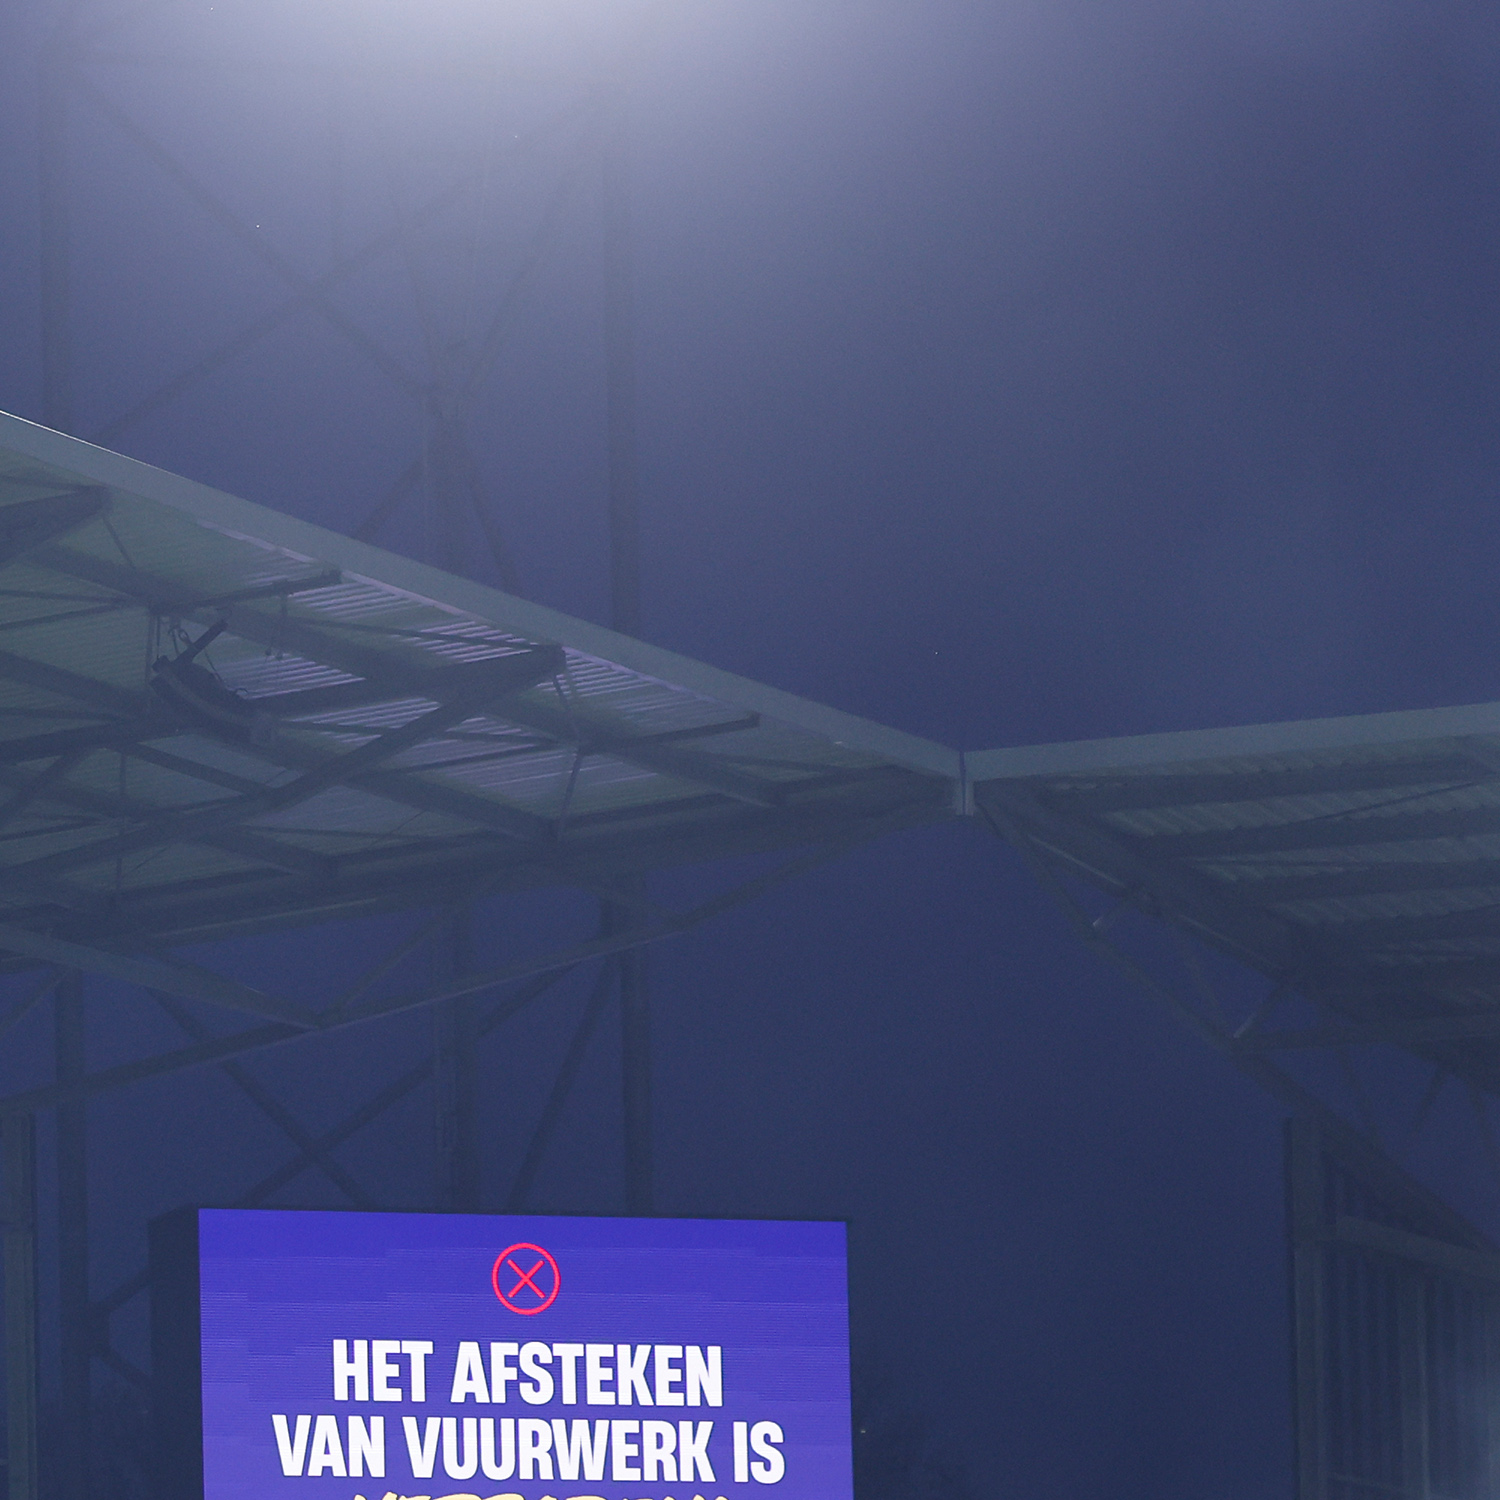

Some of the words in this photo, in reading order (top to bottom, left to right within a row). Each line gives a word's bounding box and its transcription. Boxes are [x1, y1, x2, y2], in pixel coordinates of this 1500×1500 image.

[333, 1339, 434, 1403] HET
[450, 1341, 723, 1407] AFSTEKEN
[271, 1414, 386, 1479] VAN
[402, 1416, 716, 1483] VUURWERK
[733, 1420, 786, 1484] IS
